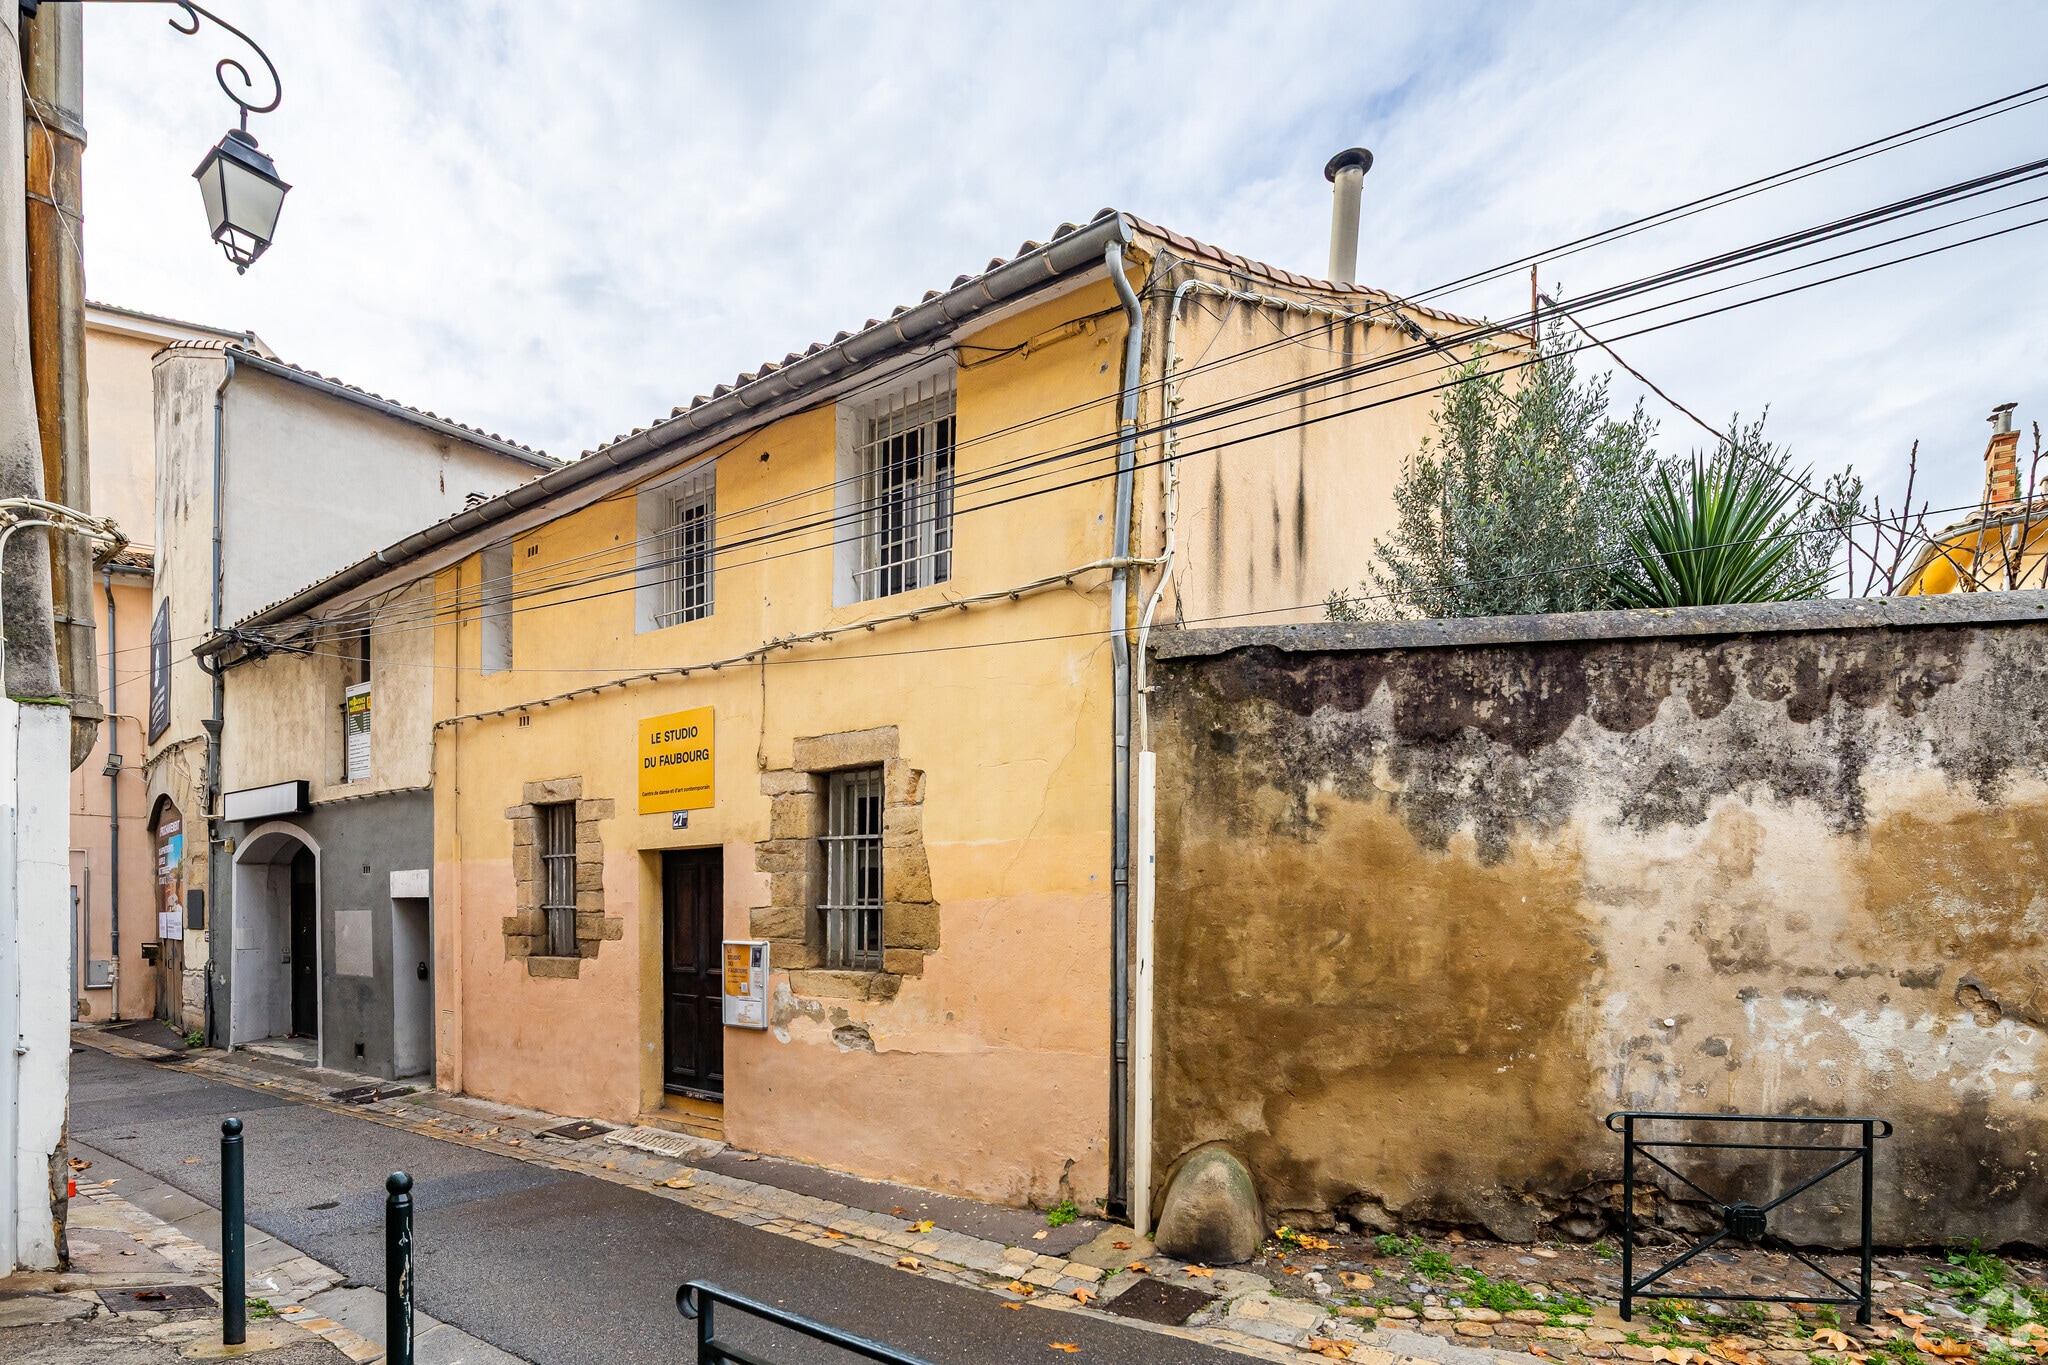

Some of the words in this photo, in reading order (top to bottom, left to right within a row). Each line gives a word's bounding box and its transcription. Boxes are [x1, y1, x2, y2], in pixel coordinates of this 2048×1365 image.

[651, 732, 661, 744] LE
[664, 726, 698, 742] STUDIO
[644, 756, 656, 769] DU
[659, 748, 709, 766] FAUBOURG
[684, 784, 710, 792] contemporain
